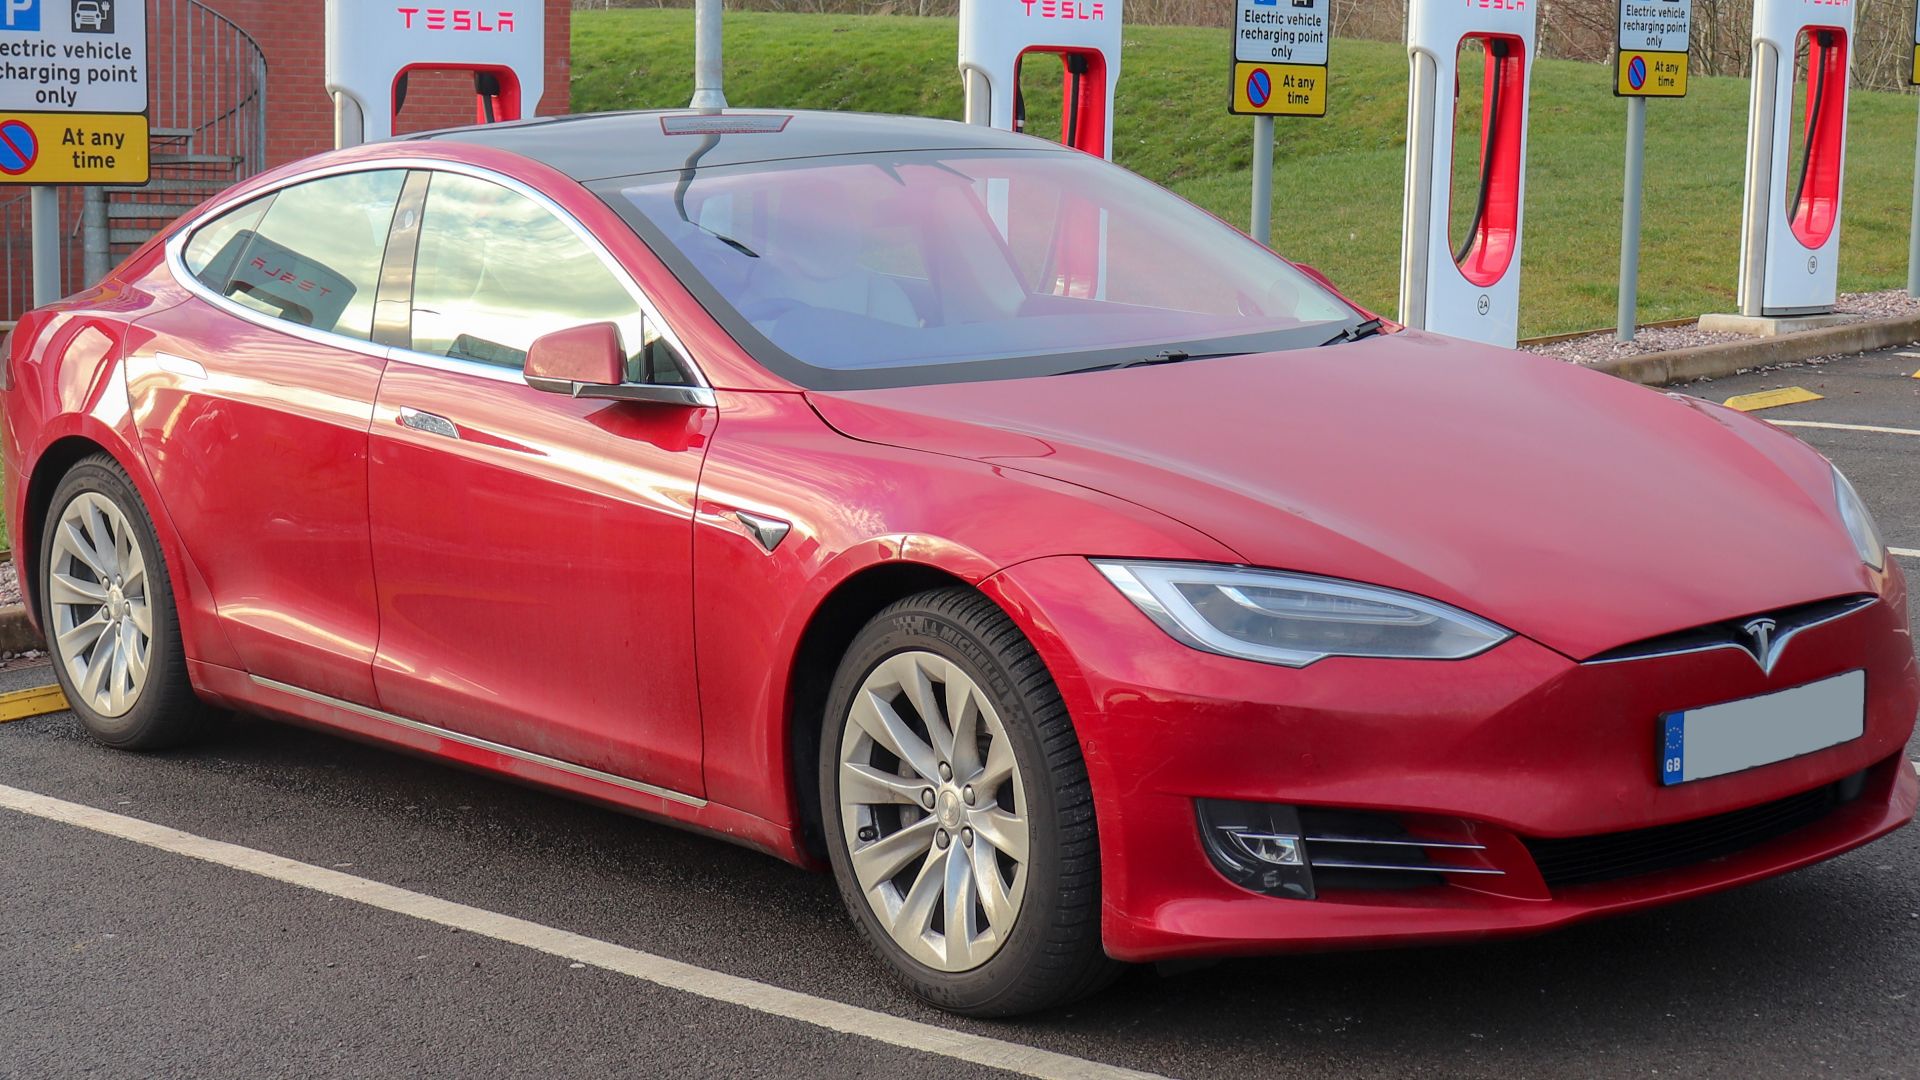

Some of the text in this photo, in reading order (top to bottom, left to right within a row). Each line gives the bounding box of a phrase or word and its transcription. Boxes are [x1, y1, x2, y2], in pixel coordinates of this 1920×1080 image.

[1020, 0, 1104, 20] TESLA
[1244, 10, 1322, 27] Electric vehicle
[1626, 4, 1686, 19] Electric vehicle
[397, 8, 514, 33] TESLA
[1623, 20, 1686, 34] recharging point
[1240, 27, 1323, 44] recharging point
[1646, 35, 1663, 48] only
[63, 41, 132, 60] vehicle
[1271, 45, 1293, 60] only
[88, 65, 138, 85] point
[1655, 61, 1679, 75] At any
[1283, 75, 1315, 91] At any
[1658, 76, 1675, 87] time
[35, 86, 77, 107] only
[1287, 92, 1309, 104] time
[62, 127, 125, 149] At any
[72, 151, 115, 169] time
[939, 625, 1010, 696] MICHELIN
[1666, 757, 1680, 773] GB
